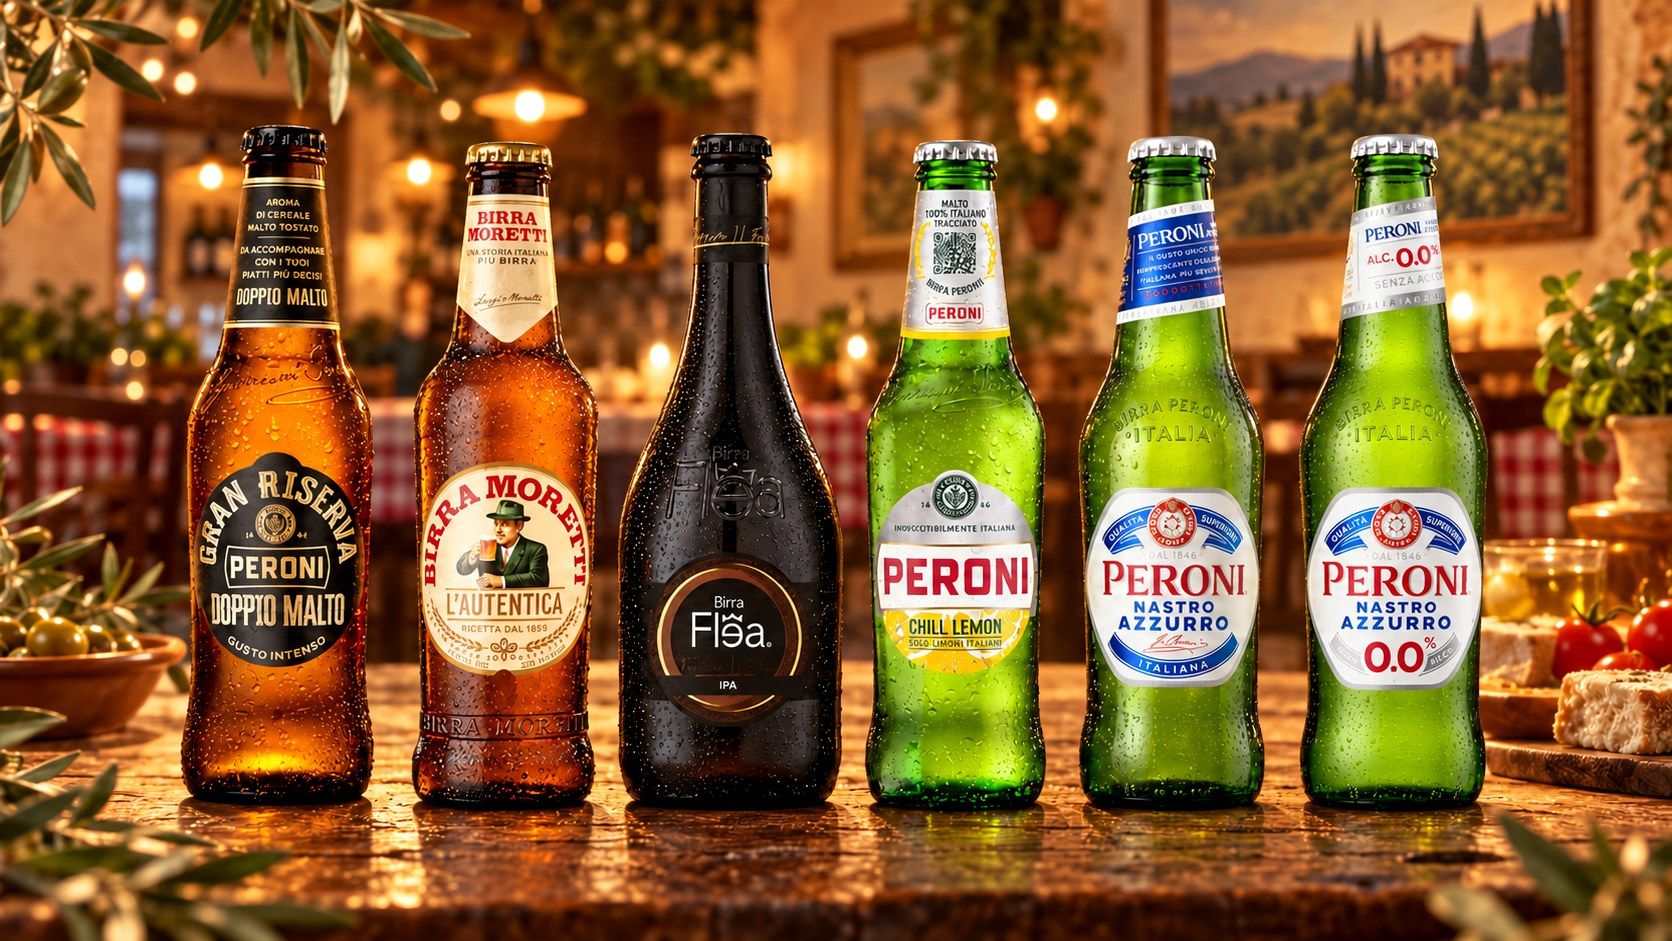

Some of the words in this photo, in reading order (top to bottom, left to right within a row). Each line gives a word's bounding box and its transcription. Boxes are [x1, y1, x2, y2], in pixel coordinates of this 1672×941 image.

[265, 198, 300, 207] AROMA
[941, 199, 969, 208] MALTO
[256, 211, 266, 219] DI
[267, 211, 310, 220] CEREALE
[477, 211, 537, 225] BIRRA
[925, 209, 949, 219] 100%
[950, 209, 987, 219] ITALIANO
[247, 223, 276, 232] MALTO
[279, 223, 319, 233] TOSTATO
[934, 219, 978, 228] TRACCIATO
[467, 227, 547, 243] MORETTI
[1137, 222, 1205, 250] PERONI
[1365, 221, 1422, 243] PERONI
[240, 246, 249, 254] DA
[250, 245, 325, 256] ACCOMPAGNARE
[481, 248, 513, 256] STORIA
[514, 248, 549, 257] ITALIANA
[1367, 252, 1394, 265] ALC.
[1396, 245, 1439, 268] 0.0%
[255, 258, 276, 267] CON
[279, 258, 282, 266] I
[285, 258, 309, 267] TUOI
[499, 257, 537, 265] BIRRA
[242, 270, 270, 279] PIATTI
[293, 270, 323, 280] DECISI
[1374, 276, 1415, 290] SENZA
[236, 287, 281, 306] DOPPIO
[287, 287, 328, 307] MALTO
[928, 306, 981, 320] PERONI
[1133, 425, 1212, 443] ITALIA
[1355, 425, 1432, 443] ITALIA
[199, 479, 249, 566] GRAN
[258, 470, 358, 565] RISERVA
[424, 483, 481, 587] BIRRA
[485, 475, 588, 587] MORETTI
[980, 524, 1016, 532] ITALIANA
[1148, 551, 1169, 559] DAL
[1172, 551, 1197, 559] 1846
[1372, 552, 1392, 560] DAL
[1396, 552, 1422, 560] 1846
[230, 555, 324, 579] PERONI
[883, 556, 1029, 596] PERONI
[1102, 560, 1246, 596] PERONI
[1322, 561, 1469, 597] PERONI
[446, 592, 563, 617] L'AUTENTICA
[714, 595, 744, 609] Birra
[1133, 600, 1215, 614] NASTRO
[1356, 601, 1437, 614] NASTRO
[211, 593, 276, 627] DOPPIO
[283, 592, 344, 627] MALTO
[461, 624, 501, 633] RICETTA
[504, 624, 524, 633] DAL
[908, 618, 949, 635] CHILL
[952, 618, 1002, 635] LEMON
[1118, 615, 1229, 631] AZZURRO
[1340, 615, 1452, 631] AZZURRO
[227, 635, 267, 660] GUSTO
[270, 635, 326, 660] INTENSO
[1364, 636, 1437, 673] 0.0%
[1138, 660, 1209, 674] ITALIANA
[719, 680, 738, 691] IPA
[423, 715, 481, 736] BIRRA
